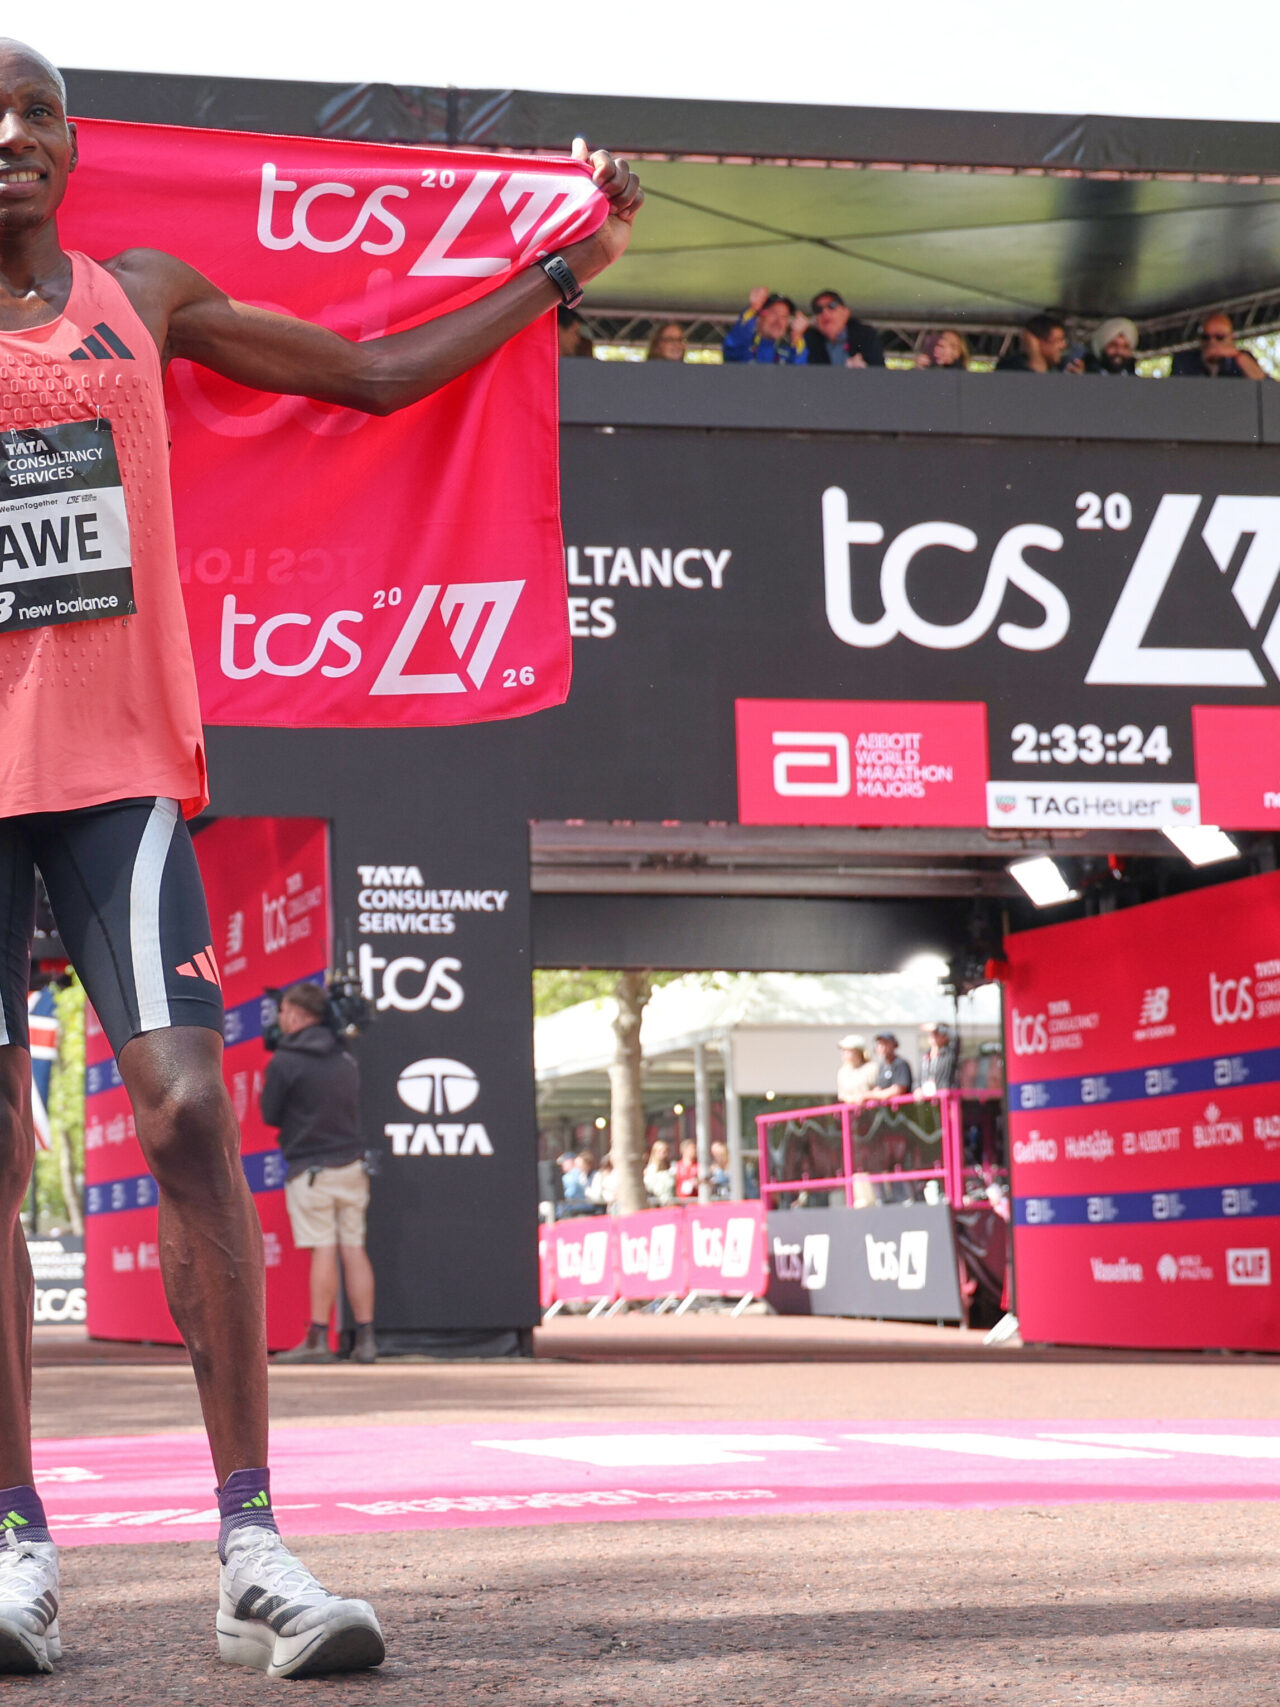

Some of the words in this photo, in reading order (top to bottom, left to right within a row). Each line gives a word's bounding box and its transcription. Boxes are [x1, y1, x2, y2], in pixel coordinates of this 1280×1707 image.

[257, 162, 410, 256] tcs
[421, 169, 455, 189] 20
[5, 440, 48, 456] TATA
[7, 448, 103, 471] CONSULTANCY
[9, 466, 74, 487] SERVICES
[566, 546, 732, 589] LTANCY
[822, 485, 1071, 651] tcs
[1075, 491, 1132, 531] 20
[18, 606, 54, 620] new
[56, 595, 119, 614] balance
[220, 594, 363, 680] tcs
[373, 586, 402, 609] 20
[502, 666, 535, 688] 26
[855, 733, 922, 749] ABBOTT
[1011, 723, 1172, 764] 2:33:24
[855, 749, 920, 765] WORLD
[856, 765, 953, 782] MARATHON
[857, 781, 926, 797] MAJORS
[357, 865, 424, 886] TATA
[358, 889, 509, 911] CONSULTANCY
[358, 913, 456, 934] SERVICES
[358, 943, 464, 1012] tcs
[1209, 972, 1254, 1025] tcs
[1012, 1008, 1047, 1056] tcs
[384, 1123, 494, 1156] TATA
